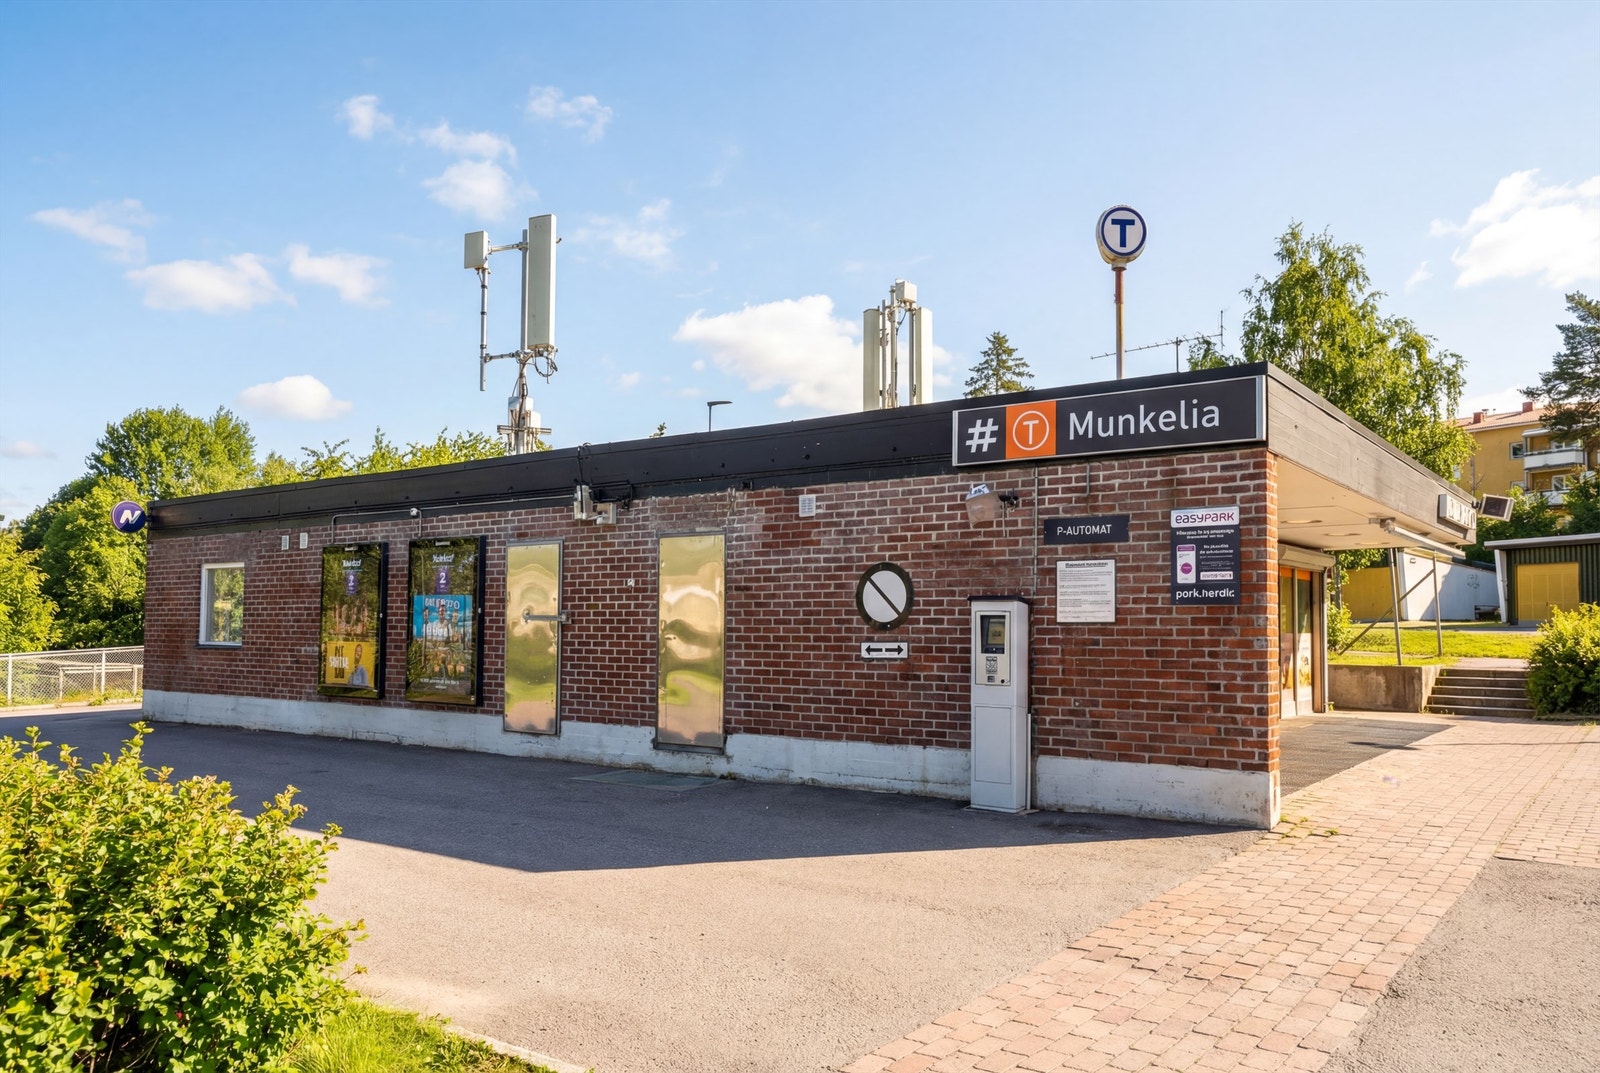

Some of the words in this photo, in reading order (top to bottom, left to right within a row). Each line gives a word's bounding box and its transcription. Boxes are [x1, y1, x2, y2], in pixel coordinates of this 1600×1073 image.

[1111, 218, 1135, 248] T
[1069, 398, 1220, 441] Munkelia
[1056, 524, 1112, 536] P-AUTOMAT
